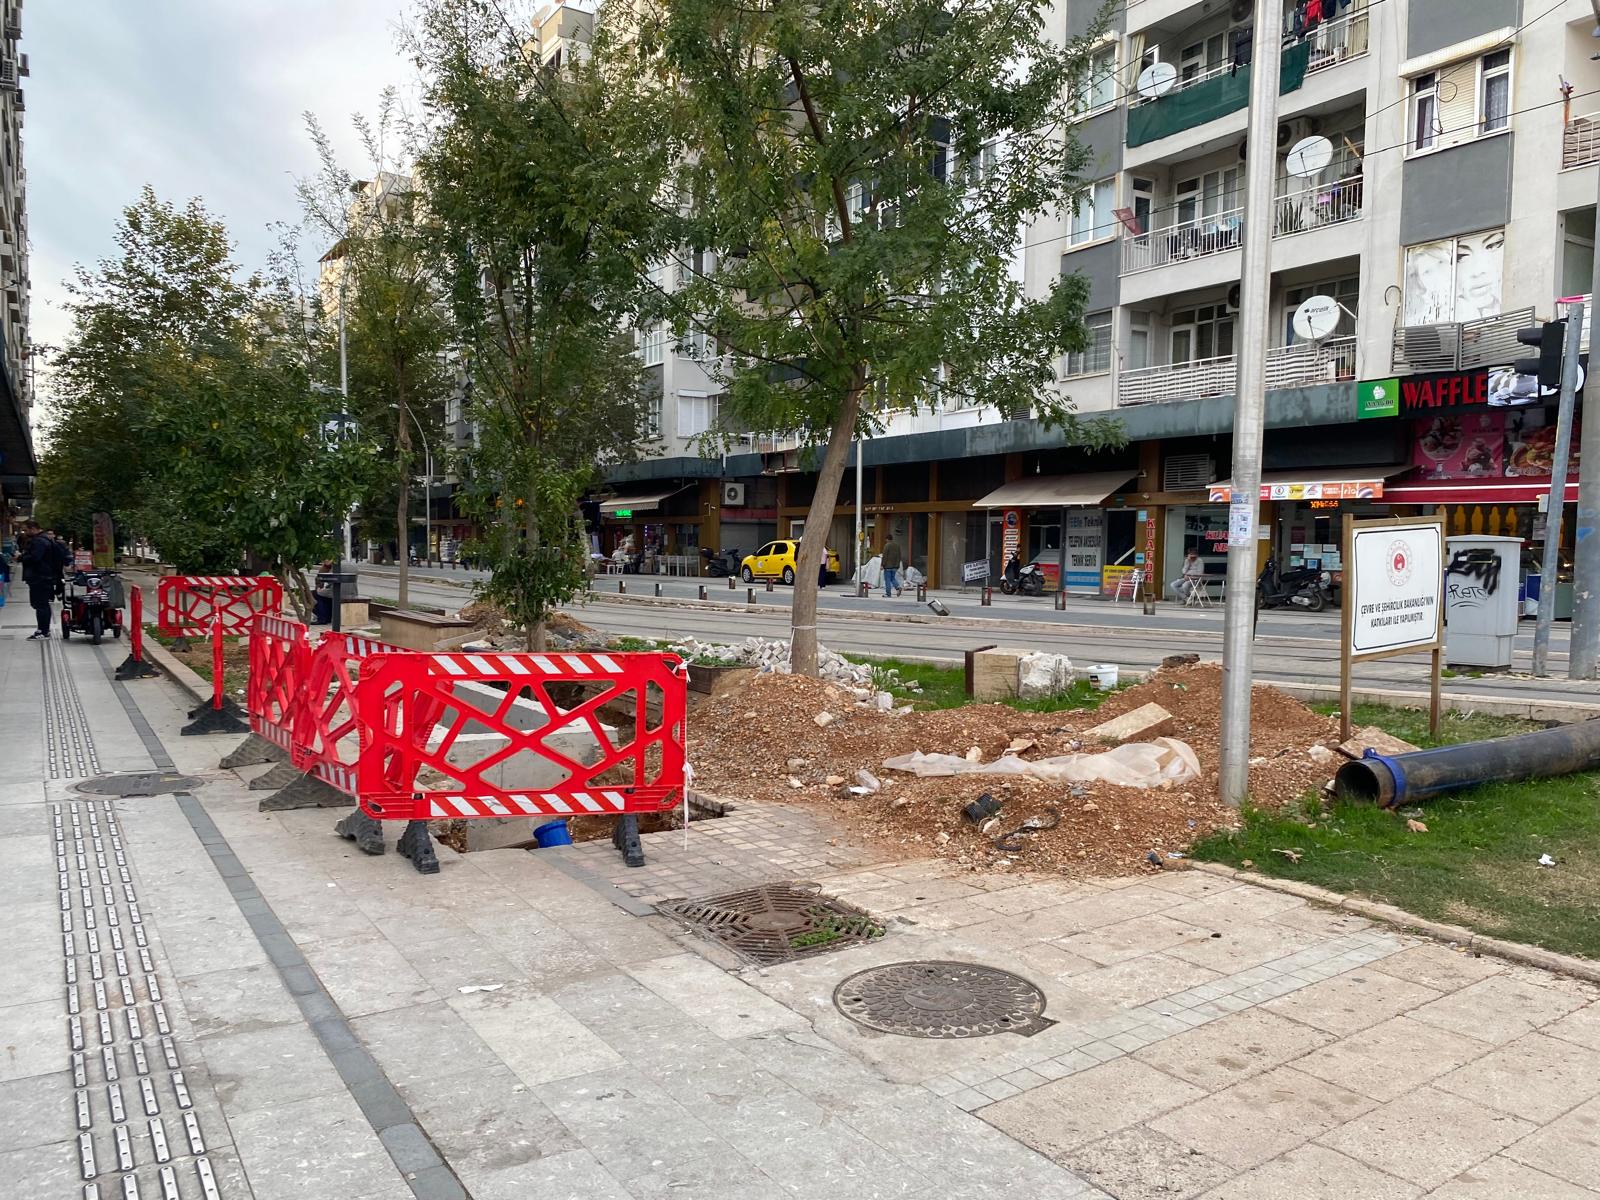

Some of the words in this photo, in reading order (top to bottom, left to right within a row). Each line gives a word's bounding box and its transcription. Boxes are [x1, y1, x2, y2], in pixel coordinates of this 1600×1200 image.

[1402, 373, 1488, 410] WAFFLE
[1361, 604, 1374, 617] ÇEVRE
[1375, 603, 1381, 612] VE
[1371, 616, 1392, 628] KATKILARI
